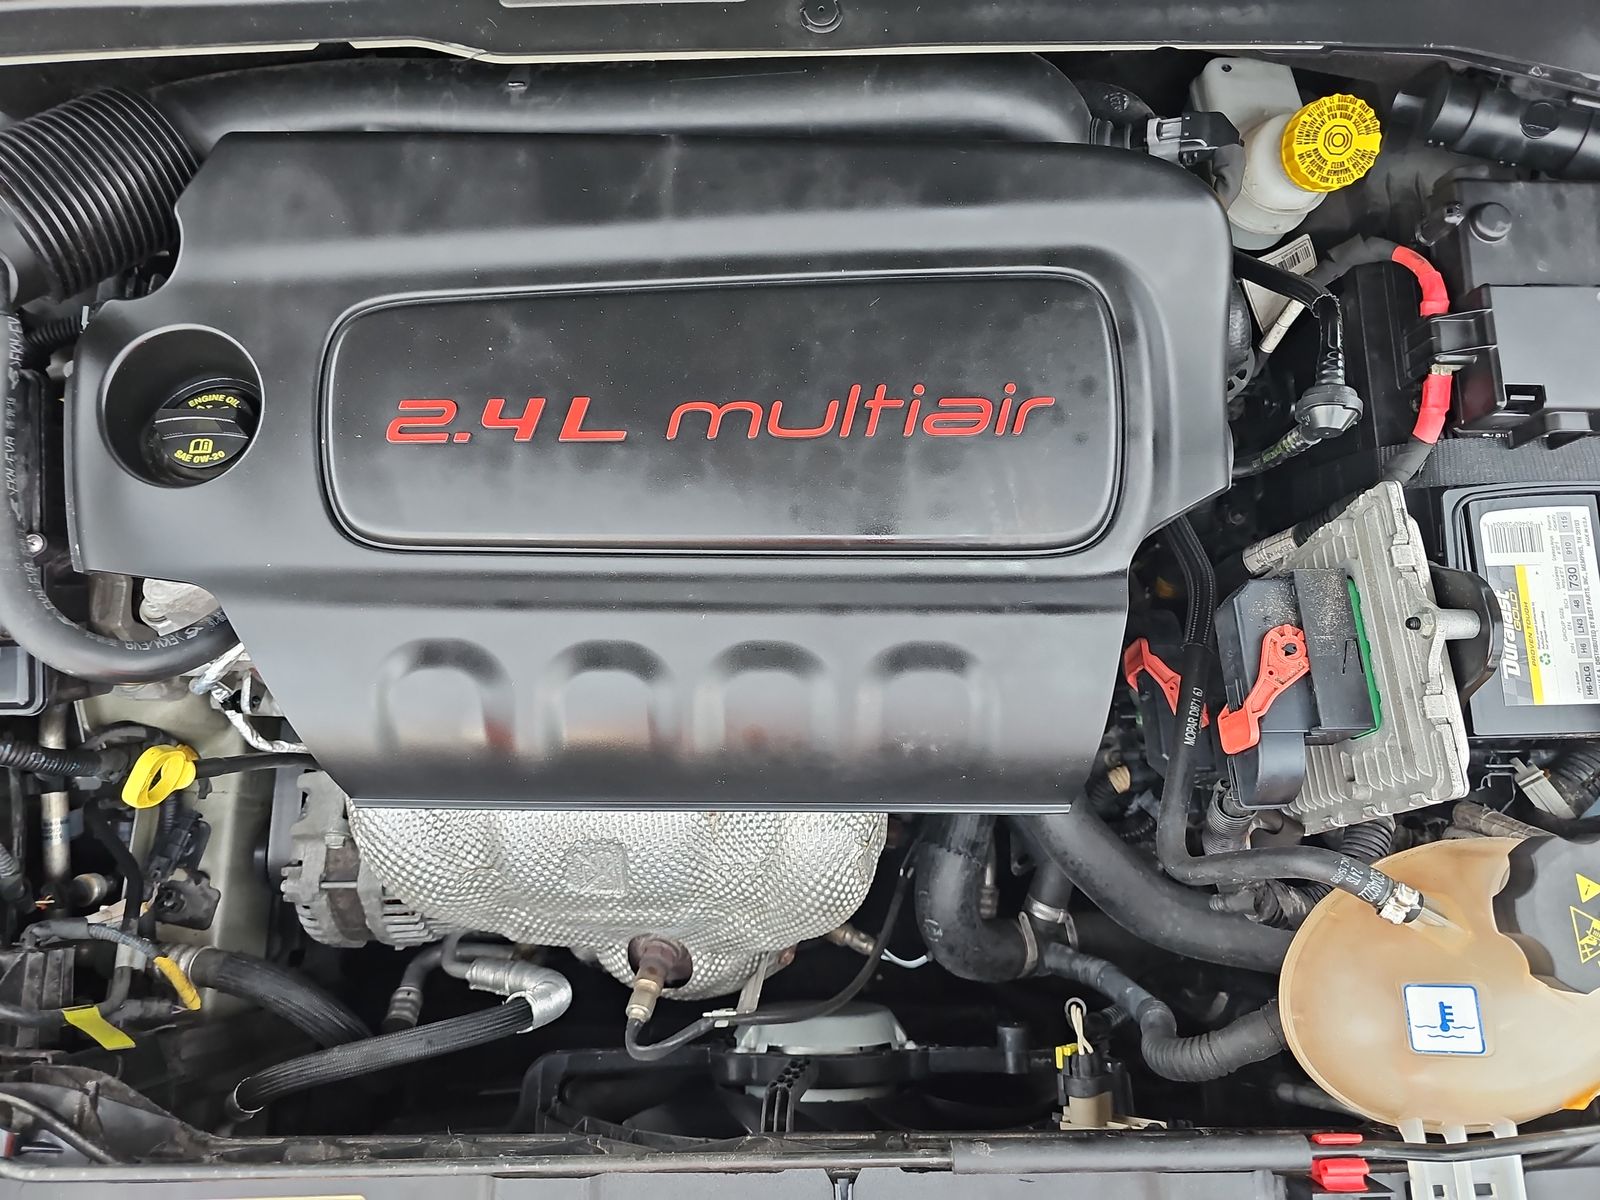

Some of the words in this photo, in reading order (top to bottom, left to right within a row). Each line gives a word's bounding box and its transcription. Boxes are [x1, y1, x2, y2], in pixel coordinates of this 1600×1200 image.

[188, 394, 226, 407] ENGINE
[225, 396, 240, 408] OIL
[665, 382, 1057, 440] multiair
[174, 450, 193, 462] SAE
[193, 450, 225, 463] 0W-20
[1560, 515, 1568, 528] 115
[1564, 541, 1572, 555] 910
[1567, 566, 1579, 588] 730
[1509, 591, 1521, 631] GOLD
[1573, 599, 1580, 609] 48
[1576, 617, 1584, 633] LN3
[1589, 620, 1595, 628] BY
[1528, 631, 1537, 667] PROVEN
[1580, 642, 1587, 653] H6
[1590, 629, 1600, 665] DISTRIBUTED
[1583, 665, 1594, 696] H6-DLG
[1189, 698, 1201, 717] D871
[1184, 717, 1198, 746] MOPAR
